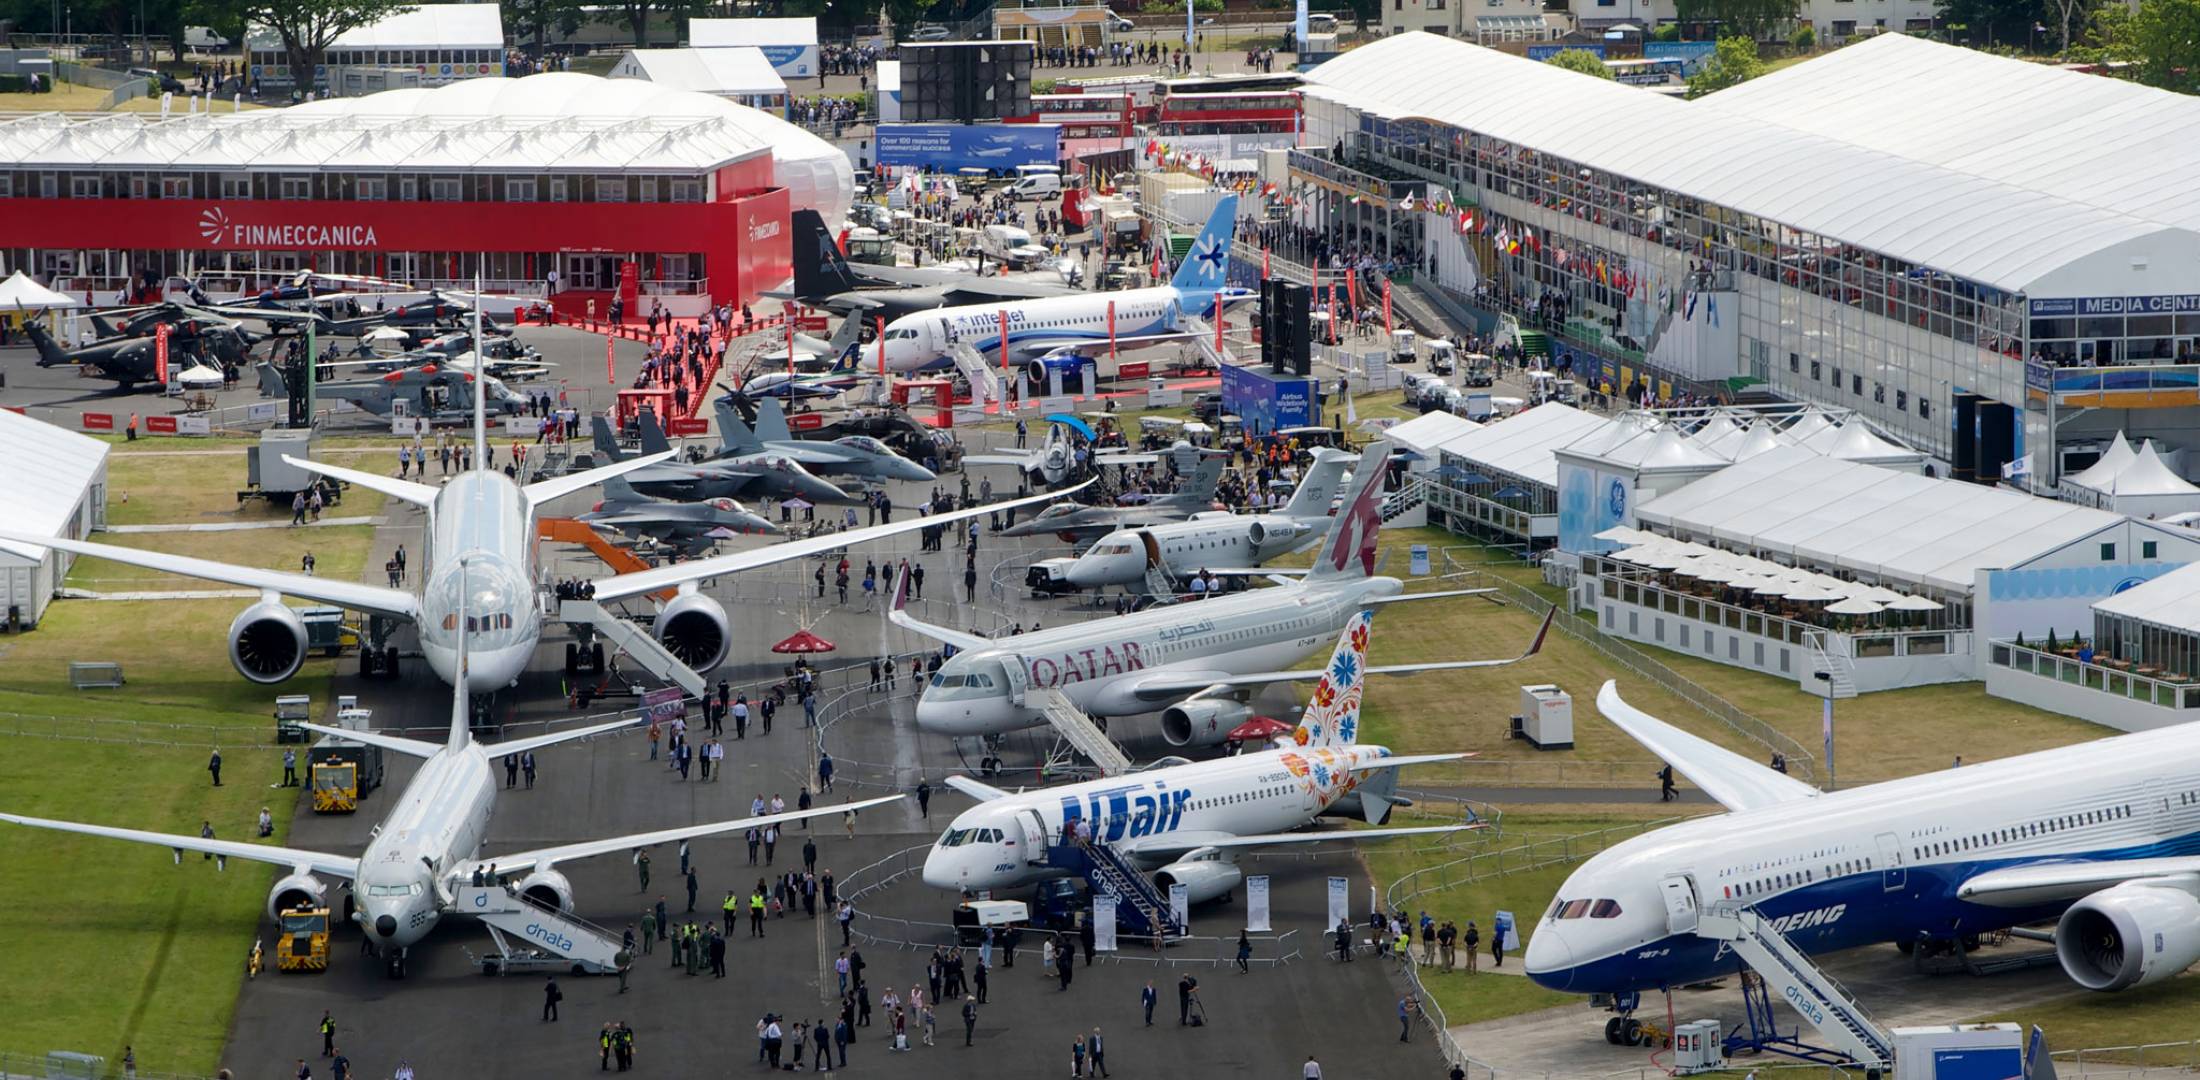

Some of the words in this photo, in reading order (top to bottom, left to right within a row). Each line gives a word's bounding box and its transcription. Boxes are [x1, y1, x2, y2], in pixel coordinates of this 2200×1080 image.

[881, 137, 898, 145] Over
[939, 137, 950, 145] for
[234, 225, 377, 246] FINMECCANICA
[2086, 297, 2144, 313] MEDIA
[1031, 641, 1144, 688] QATAR
[1091, 867, 1123, 905] dnata
[410, 909, 426, 929] 855
[526, 923, 573, 952] dnata
[1786, 984, 1824, 1025] dnata
